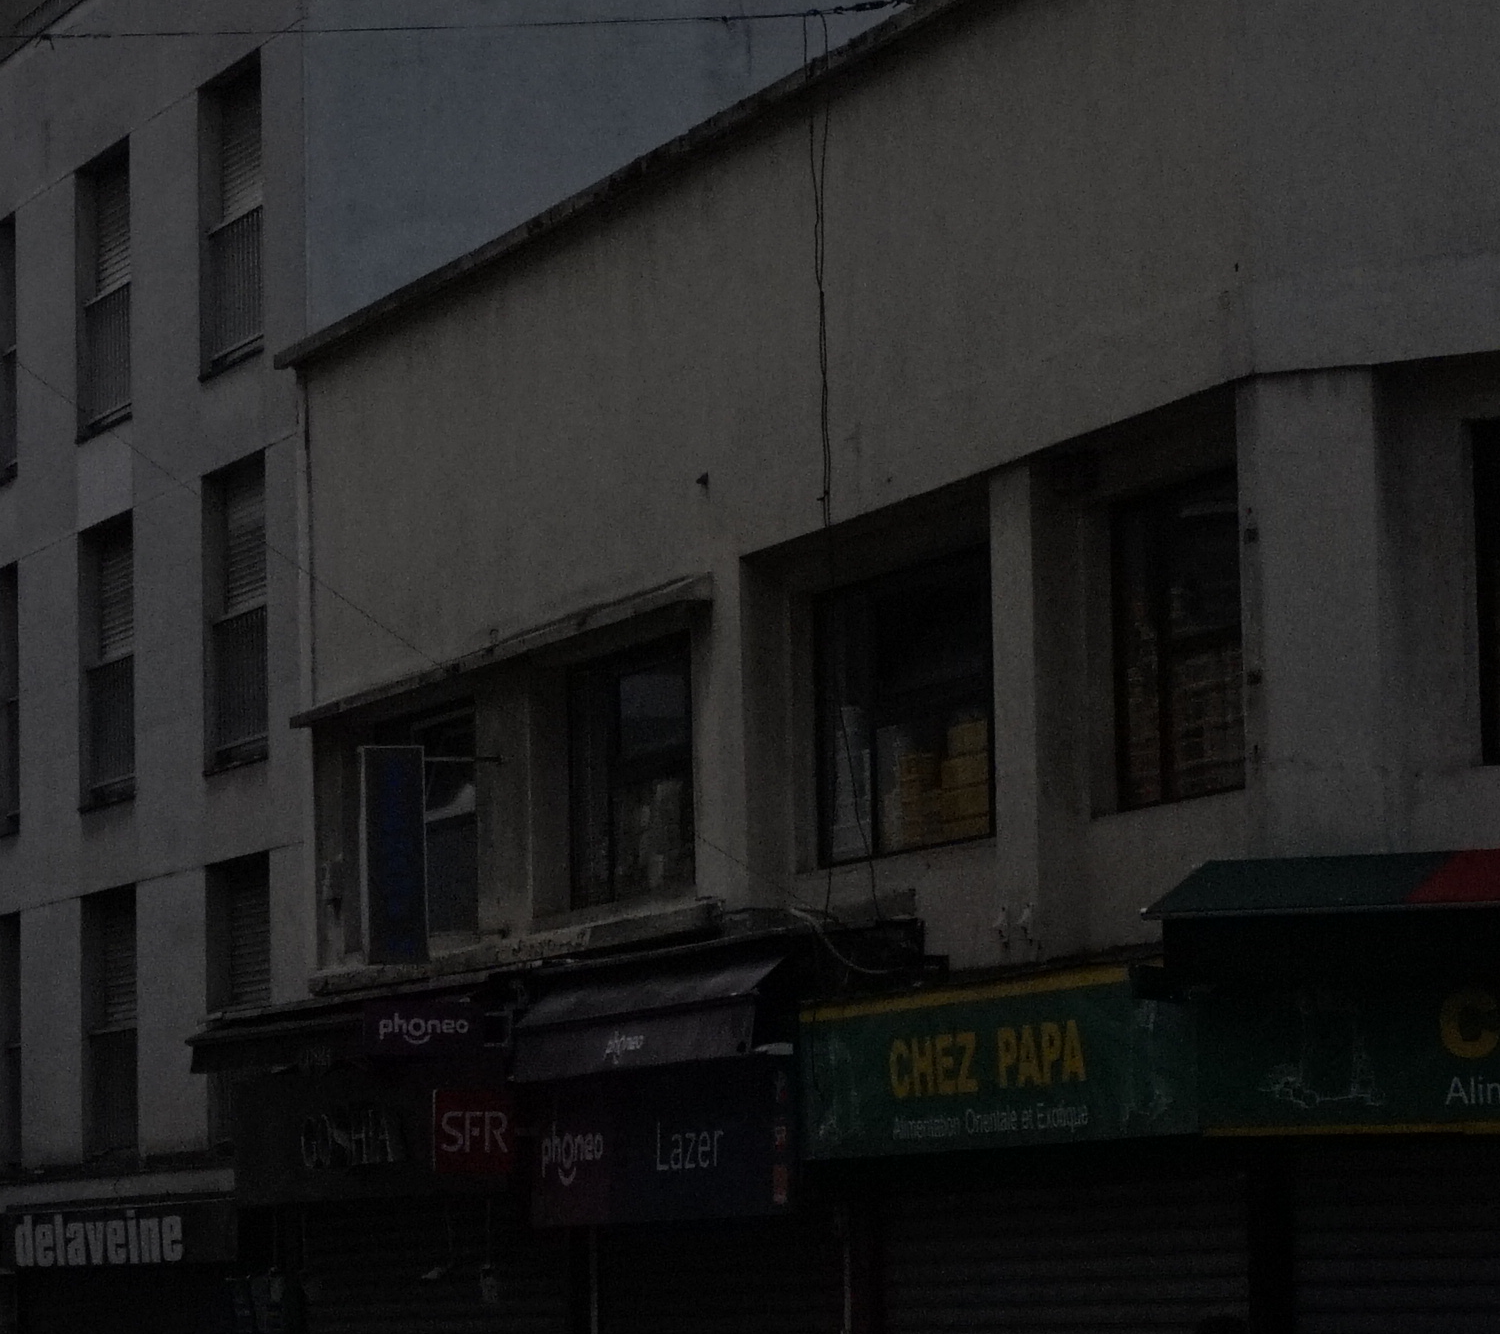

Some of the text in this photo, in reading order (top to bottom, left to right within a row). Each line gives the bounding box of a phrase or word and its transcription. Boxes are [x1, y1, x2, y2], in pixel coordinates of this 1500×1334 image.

[379, 1012, 469, 1044] phoneo
[889, 1018, 1087, 1099] CHEZ PAPA
[440, 1109, 509, 1155] SFR
[965, 1102, 1018, 1135] Orientale
[1021, 1105, 1036, 1129] et
[1036, 1100, 1089, 1133] Exotique
[541, 1121, 604, 1181] phoneo
[655, 1121, 725, 1172] Lazer
[15, 1209, 185, 1268] delaveine
